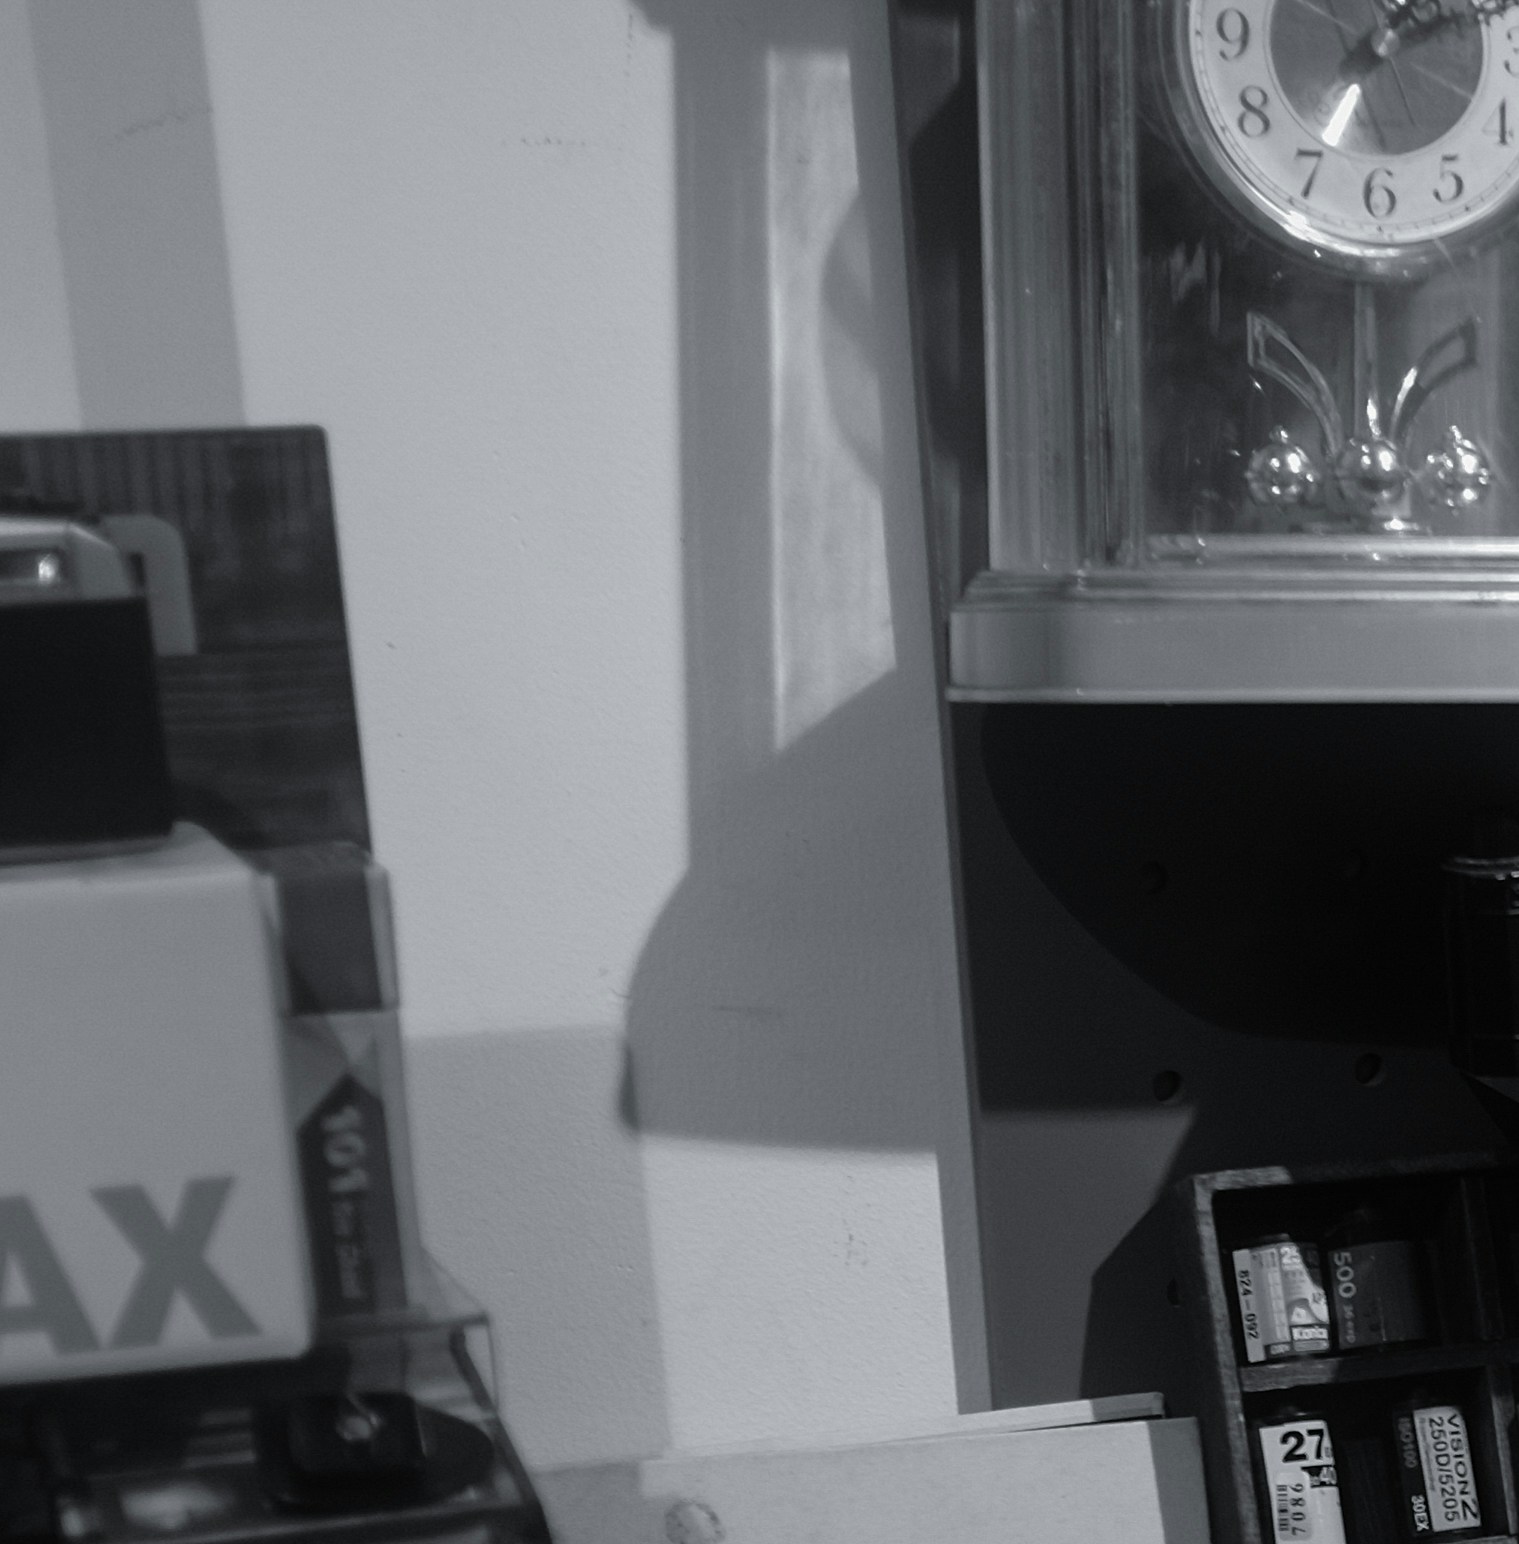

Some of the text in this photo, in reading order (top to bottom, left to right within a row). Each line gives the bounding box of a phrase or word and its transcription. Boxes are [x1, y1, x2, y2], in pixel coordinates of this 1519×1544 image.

[1216, 8, 1250, 62] 9
[1238, 85, 1271, 139] 8
[1482, 98, 1514, 147] 4
[1295, 148, 1323, 198] 7
[1363, 168, 1397, 220] 6
[1432, 154, 1465, 203] 5
[1333, 1251, 1358, 1299] 500
[1280, 1428, 1325, 1463] 27
[1428, 1415, 1456, 1522] 250D/5205
[1289, 1483, 1307, 1537] 7086
